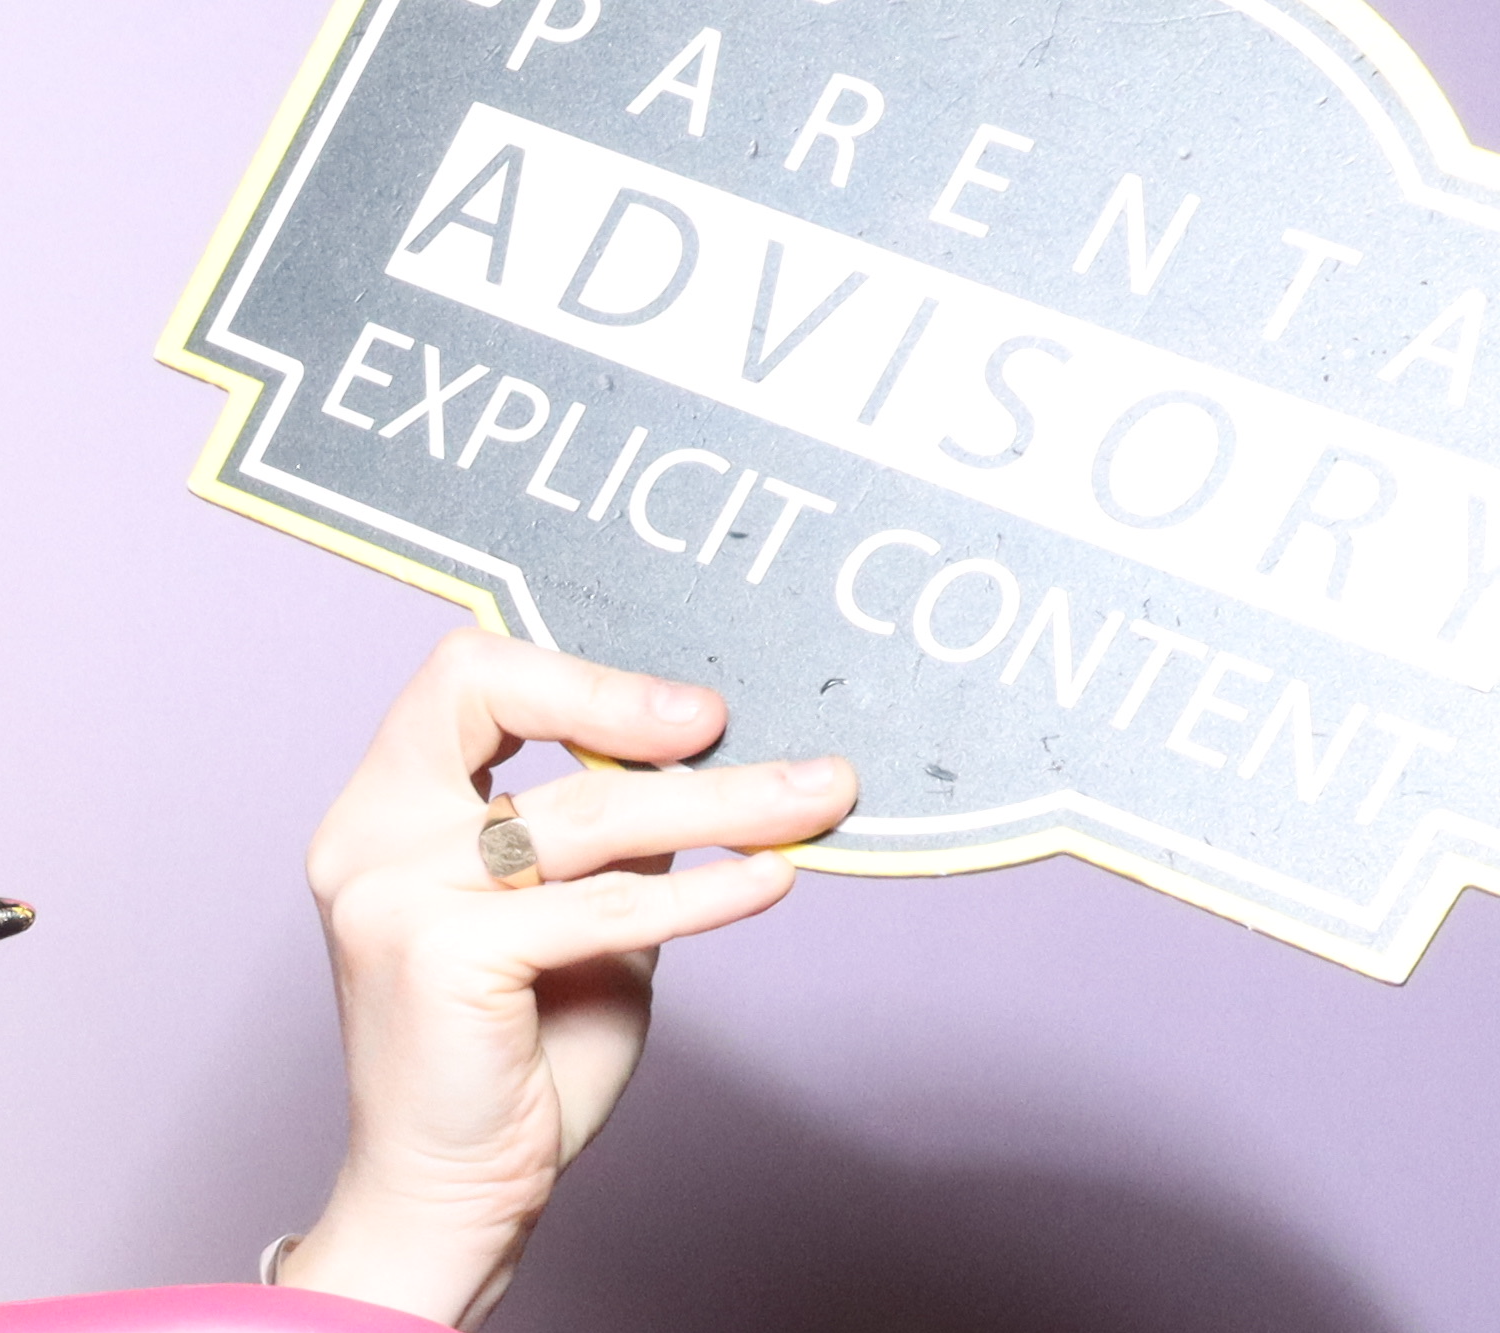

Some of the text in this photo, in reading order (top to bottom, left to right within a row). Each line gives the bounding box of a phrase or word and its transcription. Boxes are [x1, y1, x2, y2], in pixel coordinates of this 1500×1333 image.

[402, 143, 1500, 642] ADVISORY
[504, 0, 1488, 408] PARENTA
[320, 320, 1458, 829] EXPLICIT CONTENT
